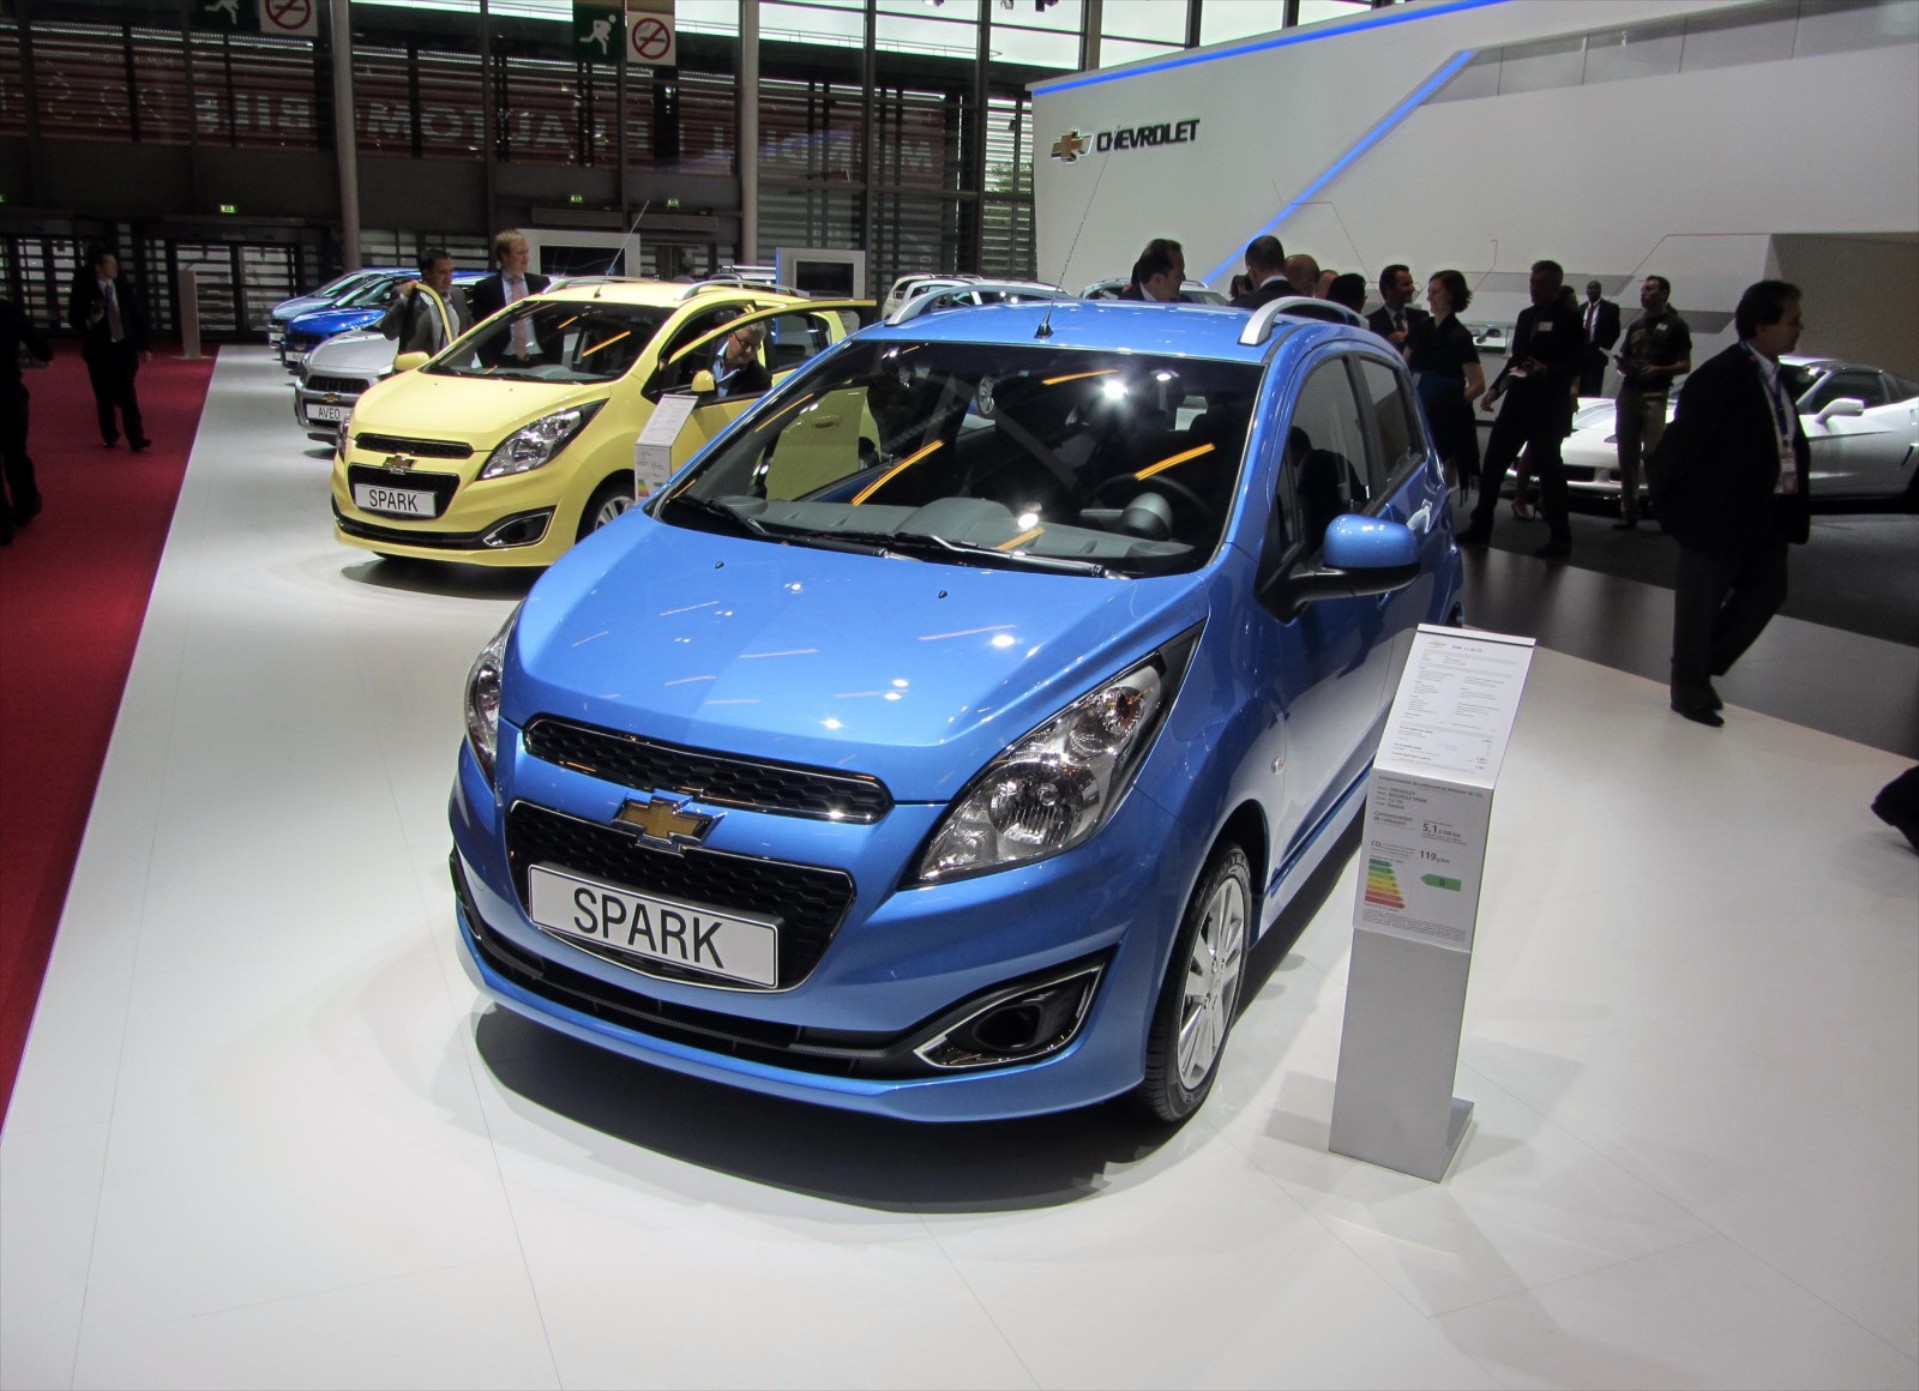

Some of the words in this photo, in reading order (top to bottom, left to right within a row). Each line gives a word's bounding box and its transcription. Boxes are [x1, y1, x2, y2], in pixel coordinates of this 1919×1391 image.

[1096, 118, 1200, 152] CHEVROLET
[318, 407, 341, 420] AVEO
[369, 489, 418, 513] SPARK
[1422, 822, 1438, 834] 5,1
[1420, 850, 1437, 861] 119
[573, 887, 724, 969] SPARK
